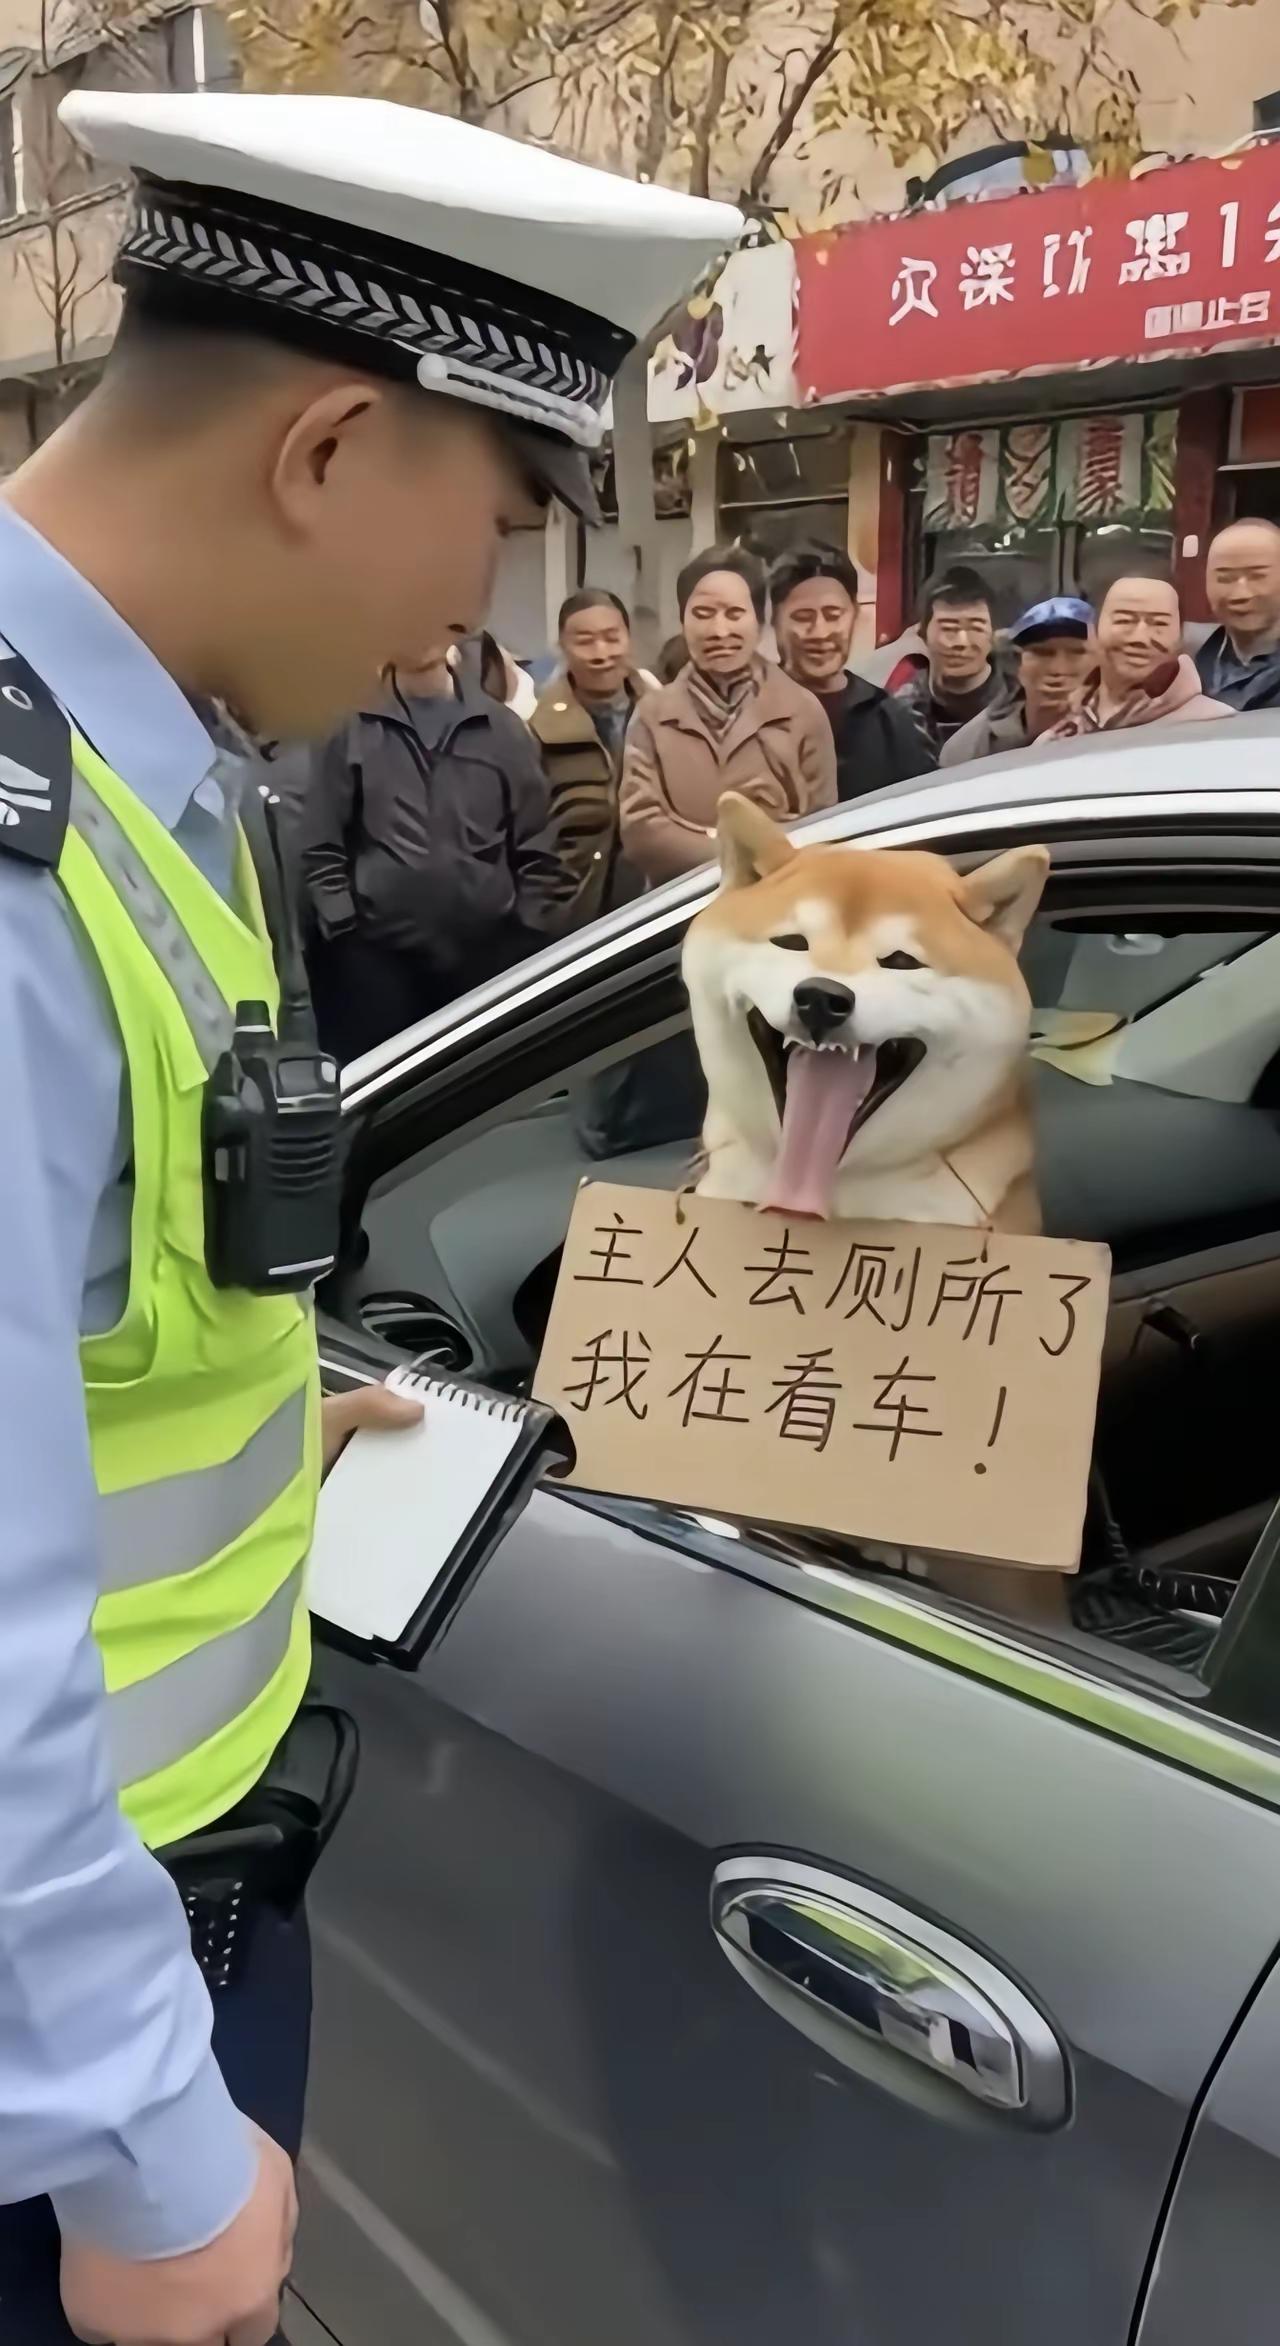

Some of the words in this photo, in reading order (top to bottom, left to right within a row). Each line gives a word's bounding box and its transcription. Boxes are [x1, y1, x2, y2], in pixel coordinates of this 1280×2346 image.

[573, 1211, 1092, 1357] 主人去厕所了
[562, 1328, 1007, 1475] 我在看车！
